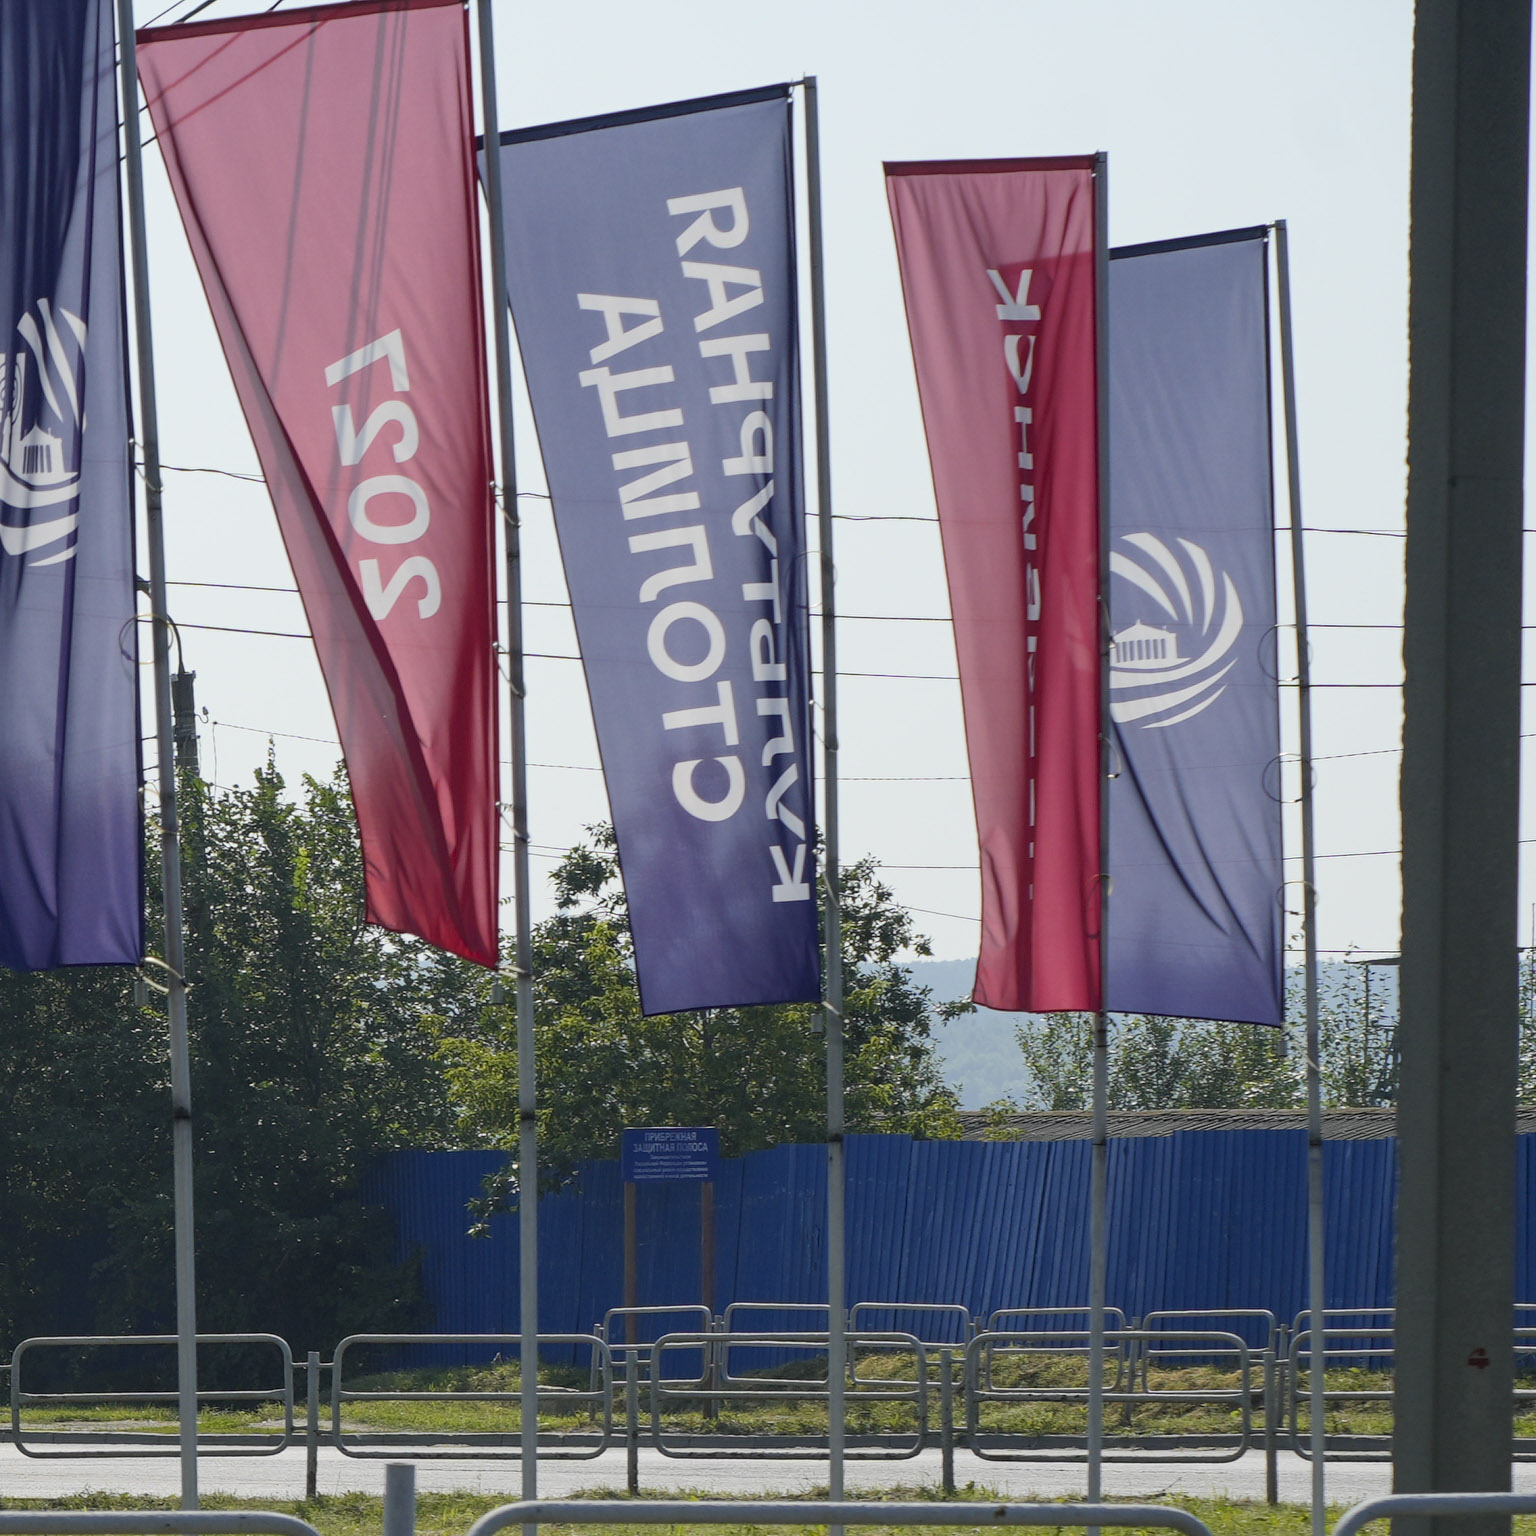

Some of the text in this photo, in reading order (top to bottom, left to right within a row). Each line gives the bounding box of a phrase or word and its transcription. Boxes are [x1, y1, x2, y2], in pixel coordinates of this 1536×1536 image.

[644, 1132, 697, 1141] ПРИБРЕЖНАЯ
[633, 1142, 708, 1153] ЗАЩИТНАЯ ПОЛОСА
